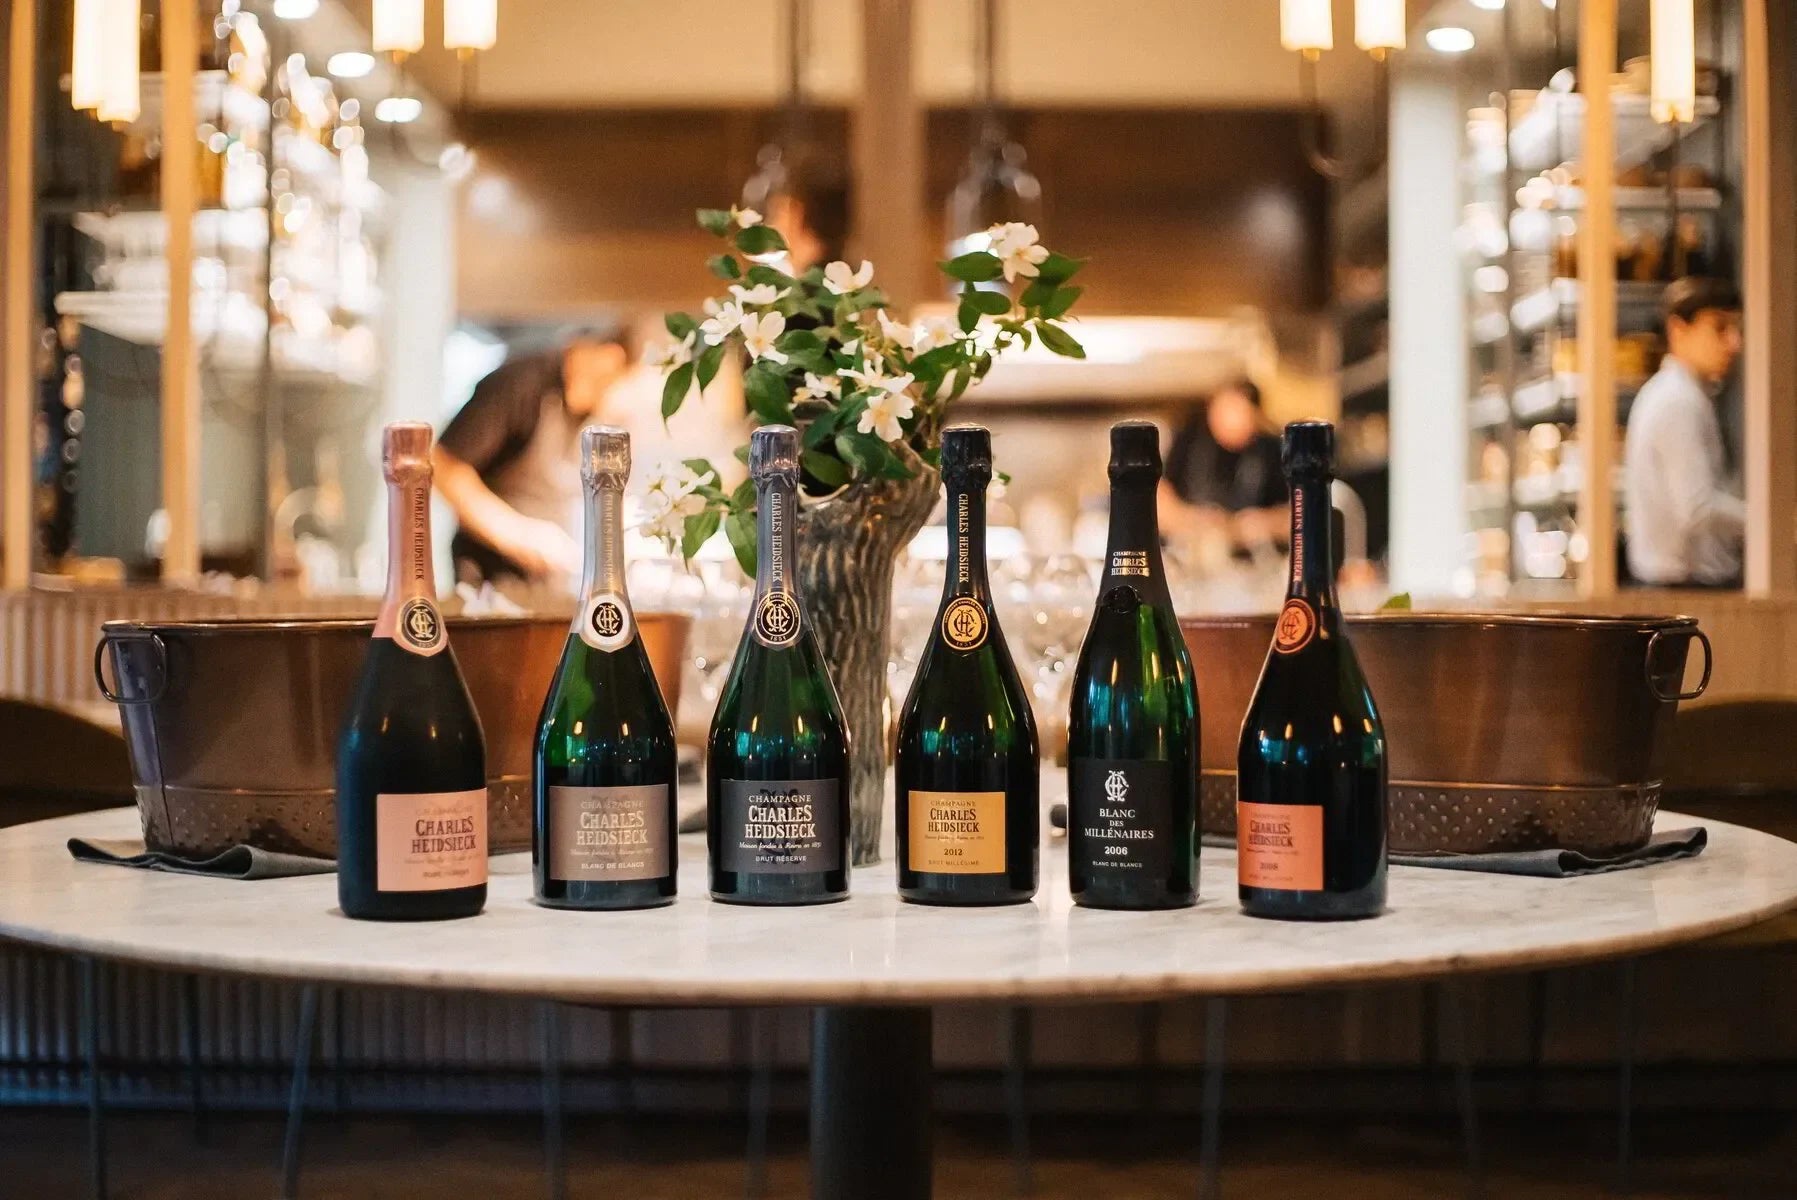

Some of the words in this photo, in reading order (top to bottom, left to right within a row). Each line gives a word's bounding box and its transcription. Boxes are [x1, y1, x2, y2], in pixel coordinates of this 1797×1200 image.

[414, 487, 425, 529] CHARLES
[771, 492, 782, 532] CHARLES
[958, 493, 969, 533] CHARLES
[414, 532, 425, 580] HEIDSIECK
[771, 534, 783, 582] HEIDSIECK
[958, 535, 969, 583] HEIDSIECK
[1112, 557, 1147, 567] CHARLES
[1111, 567, 1150, 577] HEIDSIECK
[748, 795, 812, 803] CHAMPAGNE
[580, 810, 645, 829] CHARLES
[748, 804, 813, 822] CHARLES
[930, 807, 977, 821] CHARLES
[1099, 808, 1136, 818] BLANC
[415, 816, 474, 836] CHARLES
[744, 823, 817, 839] HEIDSIECK
[928, 821, 980, 833] HEIDSIECK
[1084, 827, 1155, 839] MILLÉNAIRES
[1249, 820, 1291, 834] CHARLES
[411, 835, 477, 854] HEIDSIECK
[576, 829, 649, 846] HEIDSIECK
[775, 854, 807, 862] RÉSERVE
[943, 848, 963, 856] 2012
[1104, 846, 1128, 855] 2006
